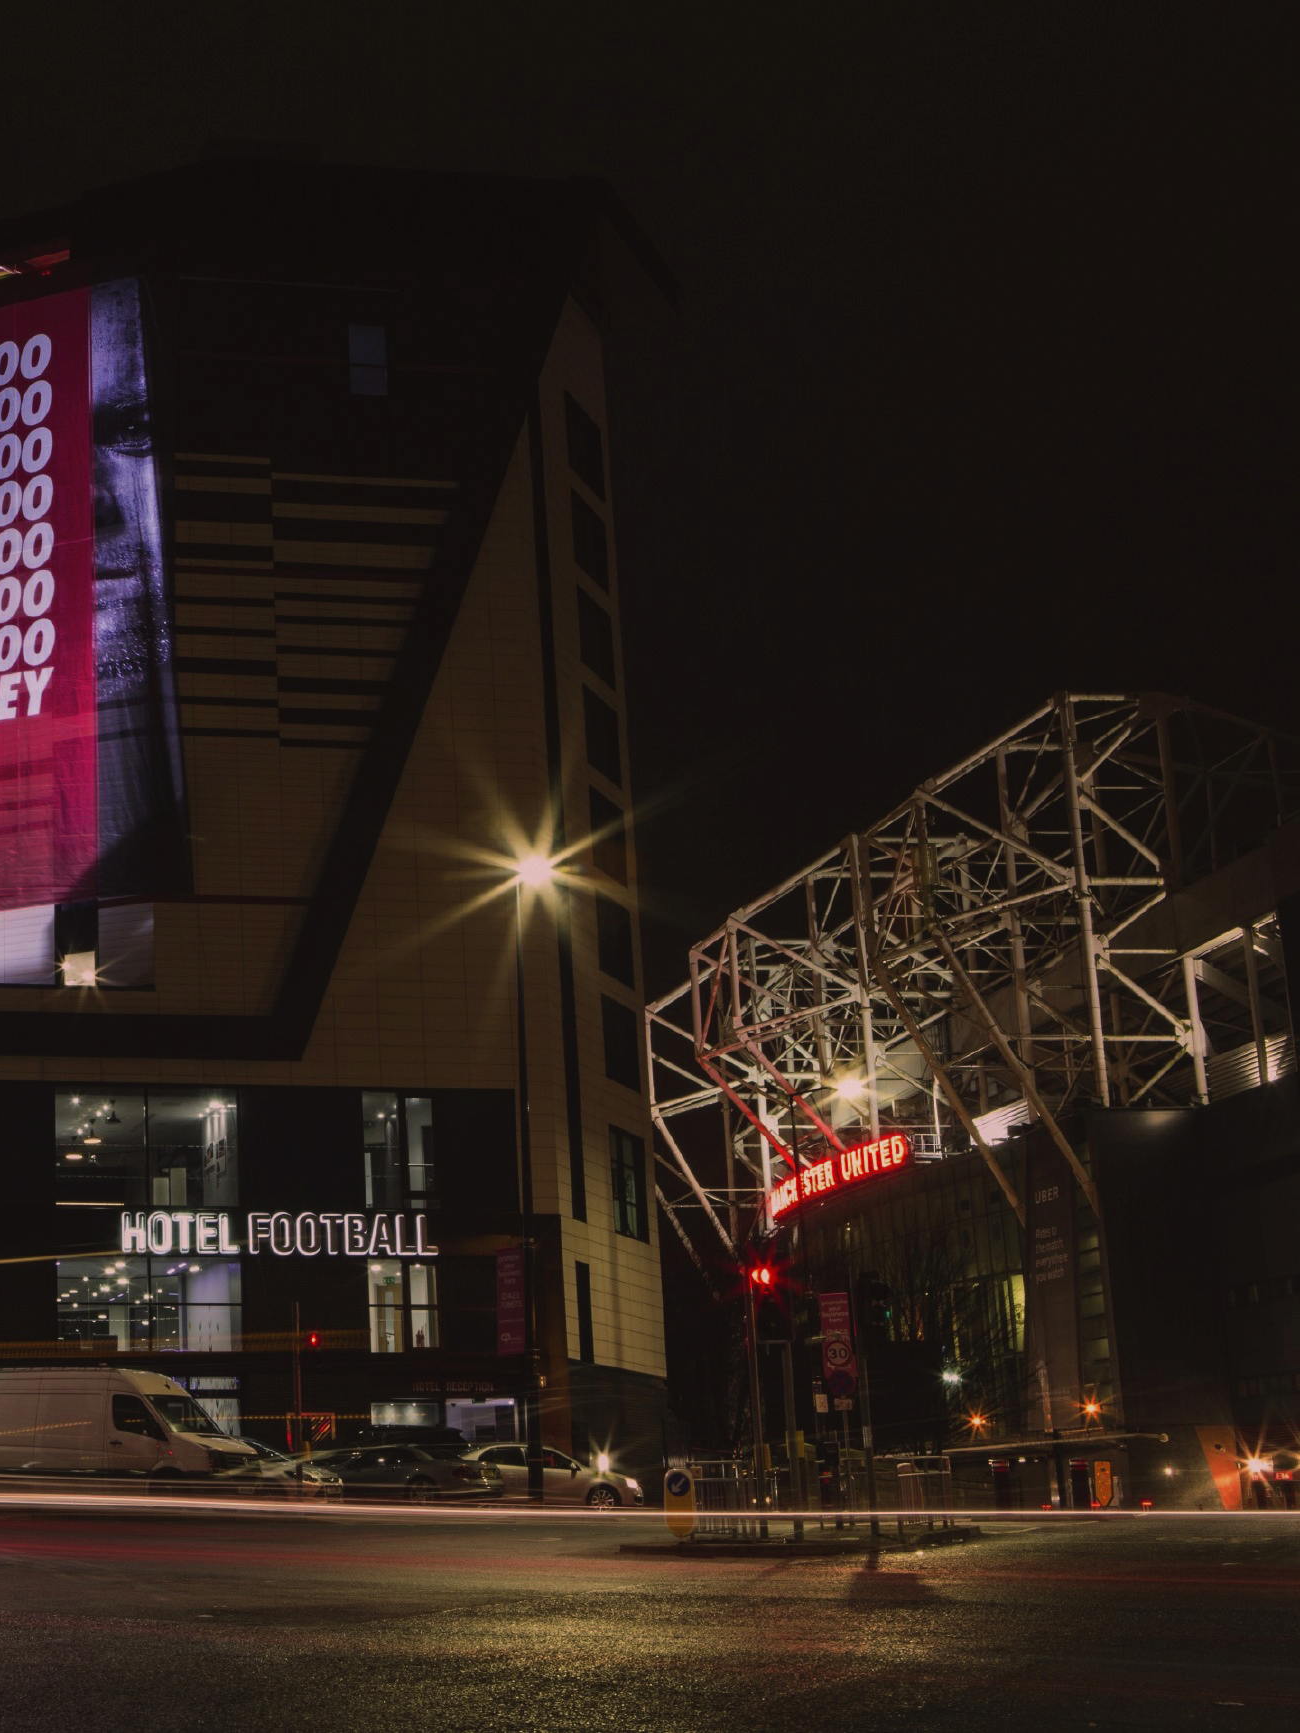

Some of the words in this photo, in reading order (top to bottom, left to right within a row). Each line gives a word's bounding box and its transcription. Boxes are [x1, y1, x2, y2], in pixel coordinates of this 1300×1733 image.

[771, 1161, 835, 1217] MANCHSTER
[841, 1135, 905, 1180] UNITED
[1034, 1186, 1059, 1204] UBER
[121, 1211, 240, 1255] HOTEL
[248, 1211, 440, 1256] FOOTBALL
[829, 1348, 848, 1359] 30
[412, 1381, 441, 1391] HOTEL
[446, 1381, 494, 1392] RECEPTION
